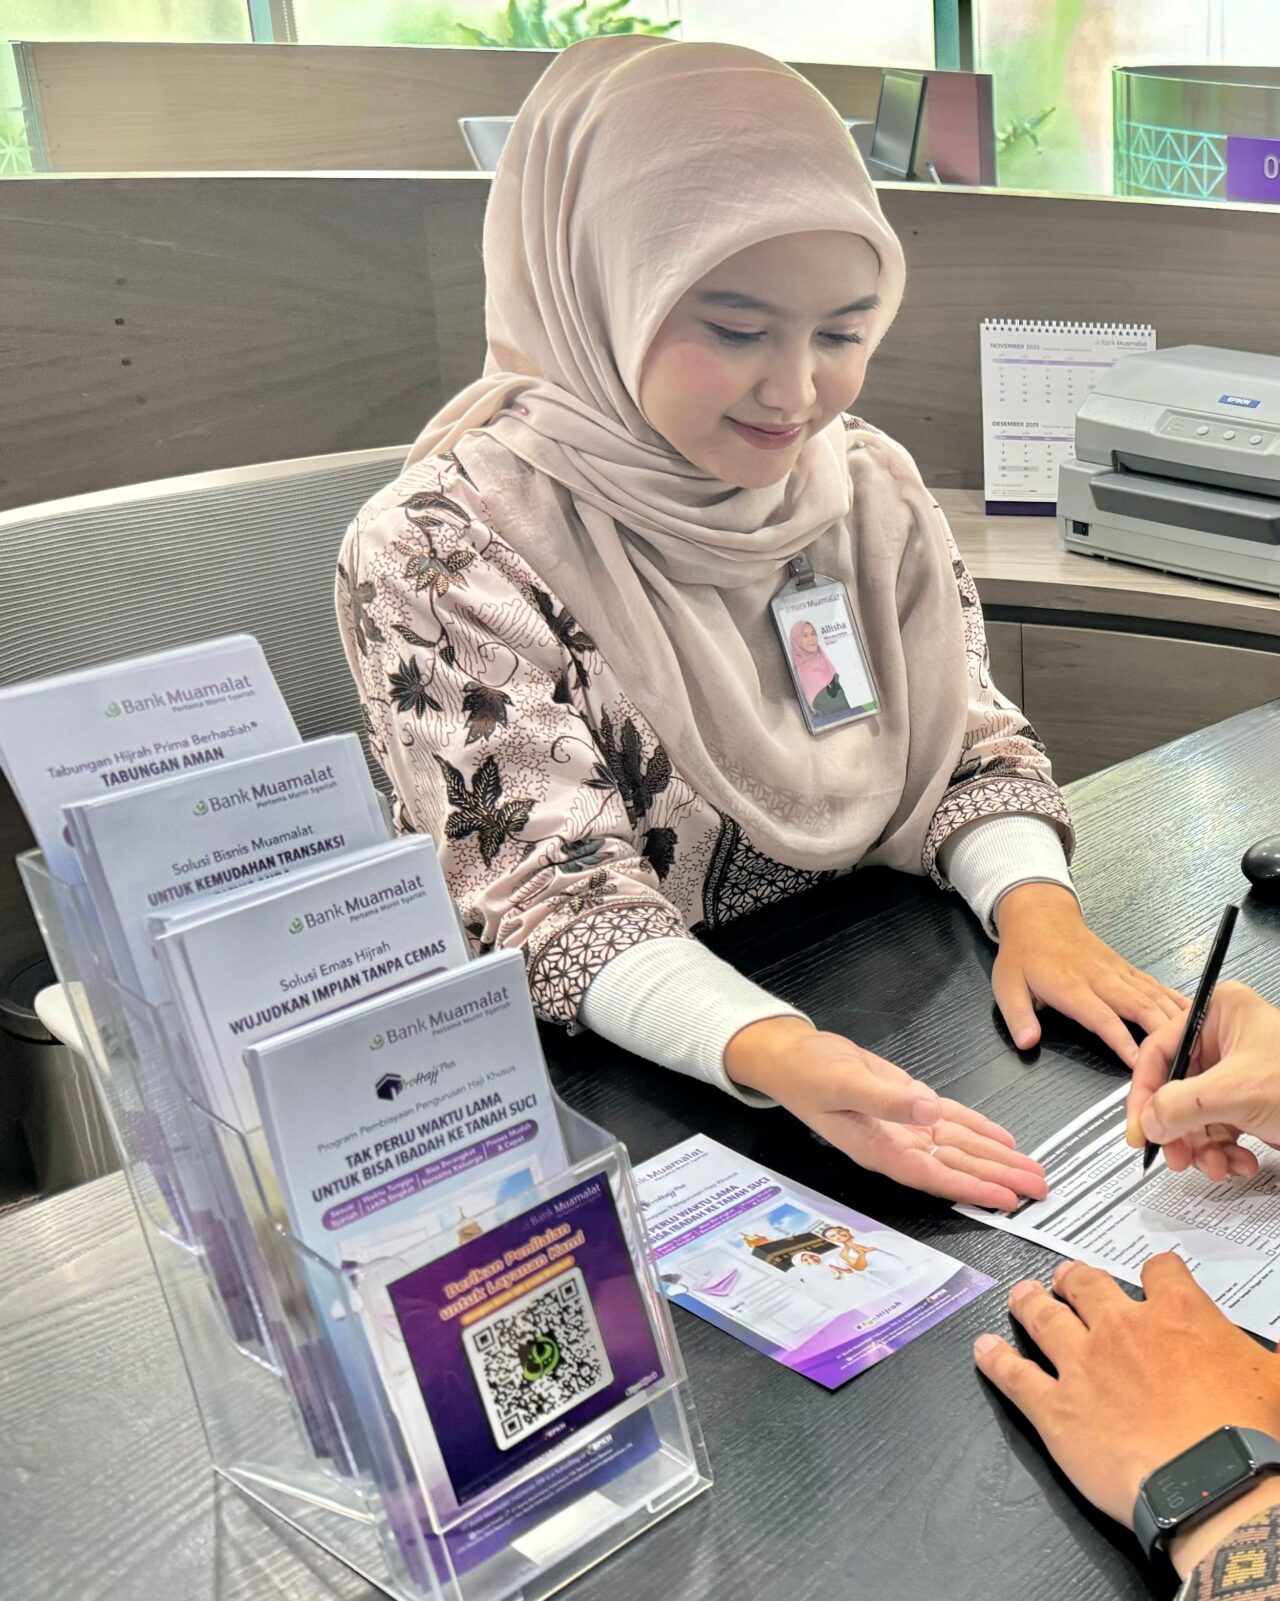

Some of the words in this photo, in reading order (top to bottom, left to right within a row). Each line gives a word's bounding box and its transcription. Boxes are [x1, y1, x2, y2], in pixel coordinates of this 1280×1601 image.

[1227, 397, 1251, 406] EPSON
[121, 693, 165, 715] Bank
[167, 675, 252, 705] Muamalat
[48, 756, 112, 779] Tabungan
[114, 745, 151, 764] Hijrah
[154, 738, 189, 755] Prima
[101, 757, 180, 787] TABUNGAN
[183, 747, 224, 769] AMAN
[209, 789, 252, 812] Bank
[251, 765, 334, 800] Muamalat
[148, 882, 194, 907] UNTUK
[195, 855, 276, 892] KEMUDAHAN
[278, 835, 346, 865] TRANSAKSI
[172, 855, 211, 876] Solusi
[213, 844, 249, 863] Bisnis
[251, 824, 314, 851] Muamalat
[304, 904, 345, 929] Bank
[345, 875, 424, 914] Muamalat
[229, 990, 311, 1035] WUJUDKAN
[312, 972, 361, 1003] IMPIAN
[361, 957, 403, 984] TANPA
[405, 940, 446, 966] CEMAS
[280, 968, 317, 992] Solusi
[320, 956, 353, 977] Emas
[355, 941, 391, 964] Hijrah
[386, 1018, 427, 1044] Bank
[429, 987, 509, 1028] Muamalat
[440, 1060, 456, 1072] Plus
[317, 1132, 358, 1153] Program
[360, 1108, 414, 1134] Pembiayaan
[467, 1078, 485, 1092] Haji
[345, 1147, 372, 1170] TAK
[374, 1130, 417, 1157] PERLU
[417, 1108, 464, 1138] WAKTU
[466, 1092, 503, 1117] LAMA
[311, 1173, 360, 1203] UNTUK
[362, 1159, 393, 1181] BISA
[395, 1135, 446, 1168] IBADAH
[448, 1125, 464, 1143] KE
[463, 1109, 508, 1136] TANAH
[510, 1094, 538, 1116] SUCI
[646, 1148, 704, 1178] Muamalat
[553, 1183, 601, 1214] Muamalat
[648, 1215, 680, 1234] PERLU
[677, 1198, 713, 1218] WAKTU
[710, 1184, 740, 1204] LAMA
[670, 1211, 706, 1232] IBADAH
[705, 1203, 720, 1217] KE
[717, 1188, 750, 1208] TANAH
[746, 1176, 770, 1191] SUCI
[439, 1288, 487, 1321] untuk
[486, 1253, 549, 1296] Layanan
[547, 1229, 586, 1261] Kami
[444, 1259, 505, 1299] Berikan
[503, 1223, 572, 1266] Penilaian
